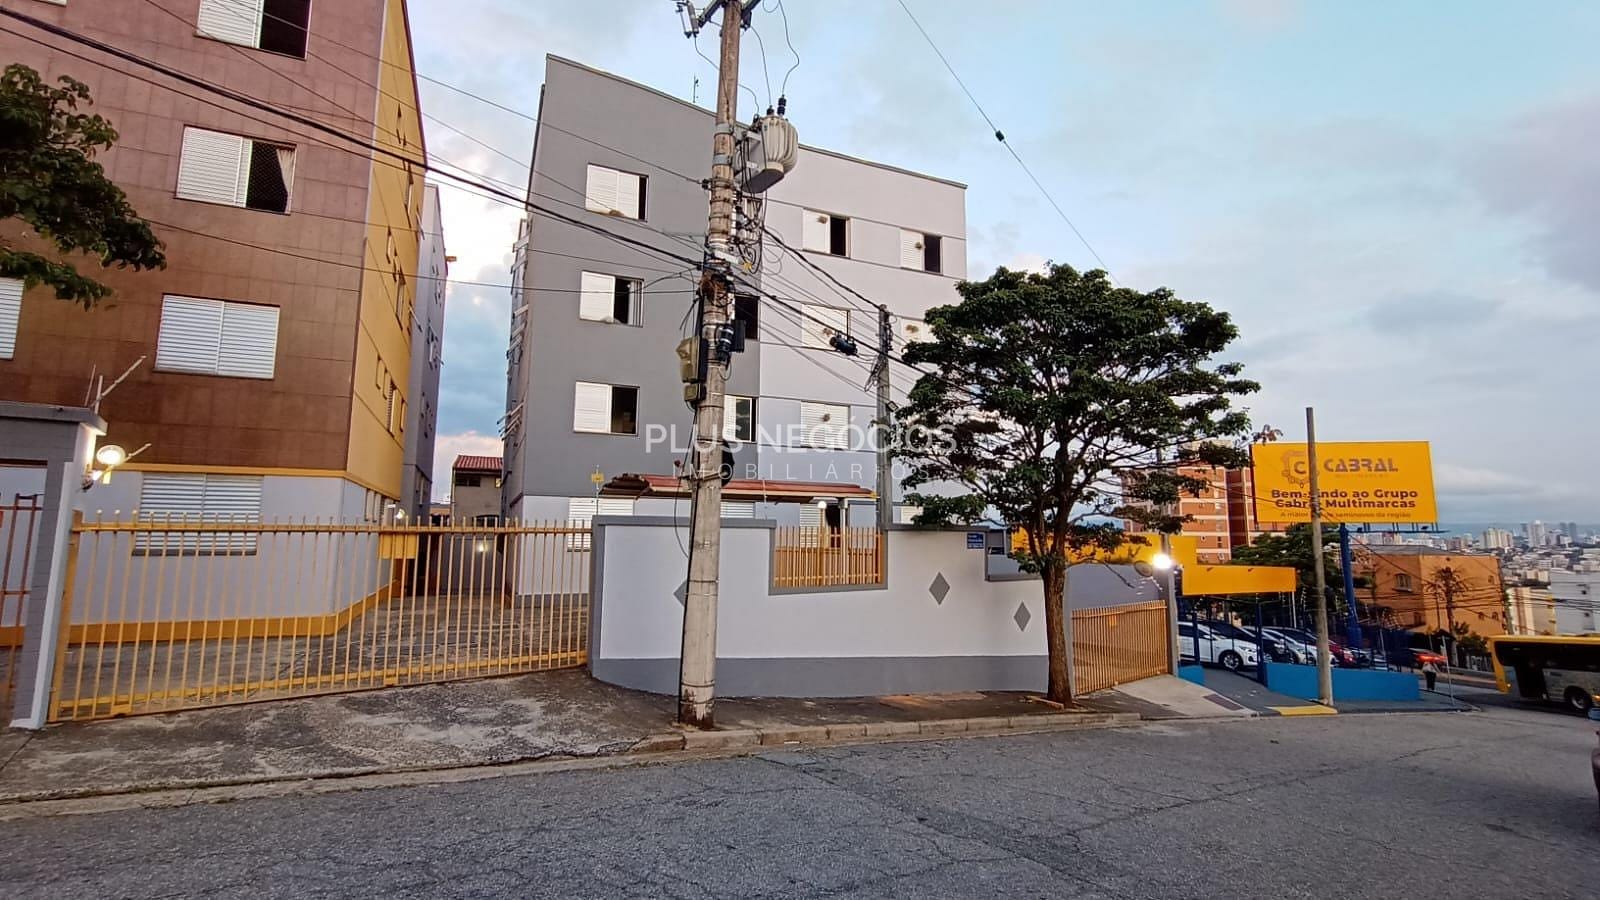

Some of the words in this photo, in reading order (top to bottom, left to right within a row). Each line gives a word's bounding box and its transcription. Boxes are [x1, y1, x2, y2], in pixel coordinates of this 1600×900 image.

[1324, 458, 1398, 472] CABRAL
[1374, 489, 1418, 500] Grupo
[1326, 498, 1416, 508] Multimarcas
